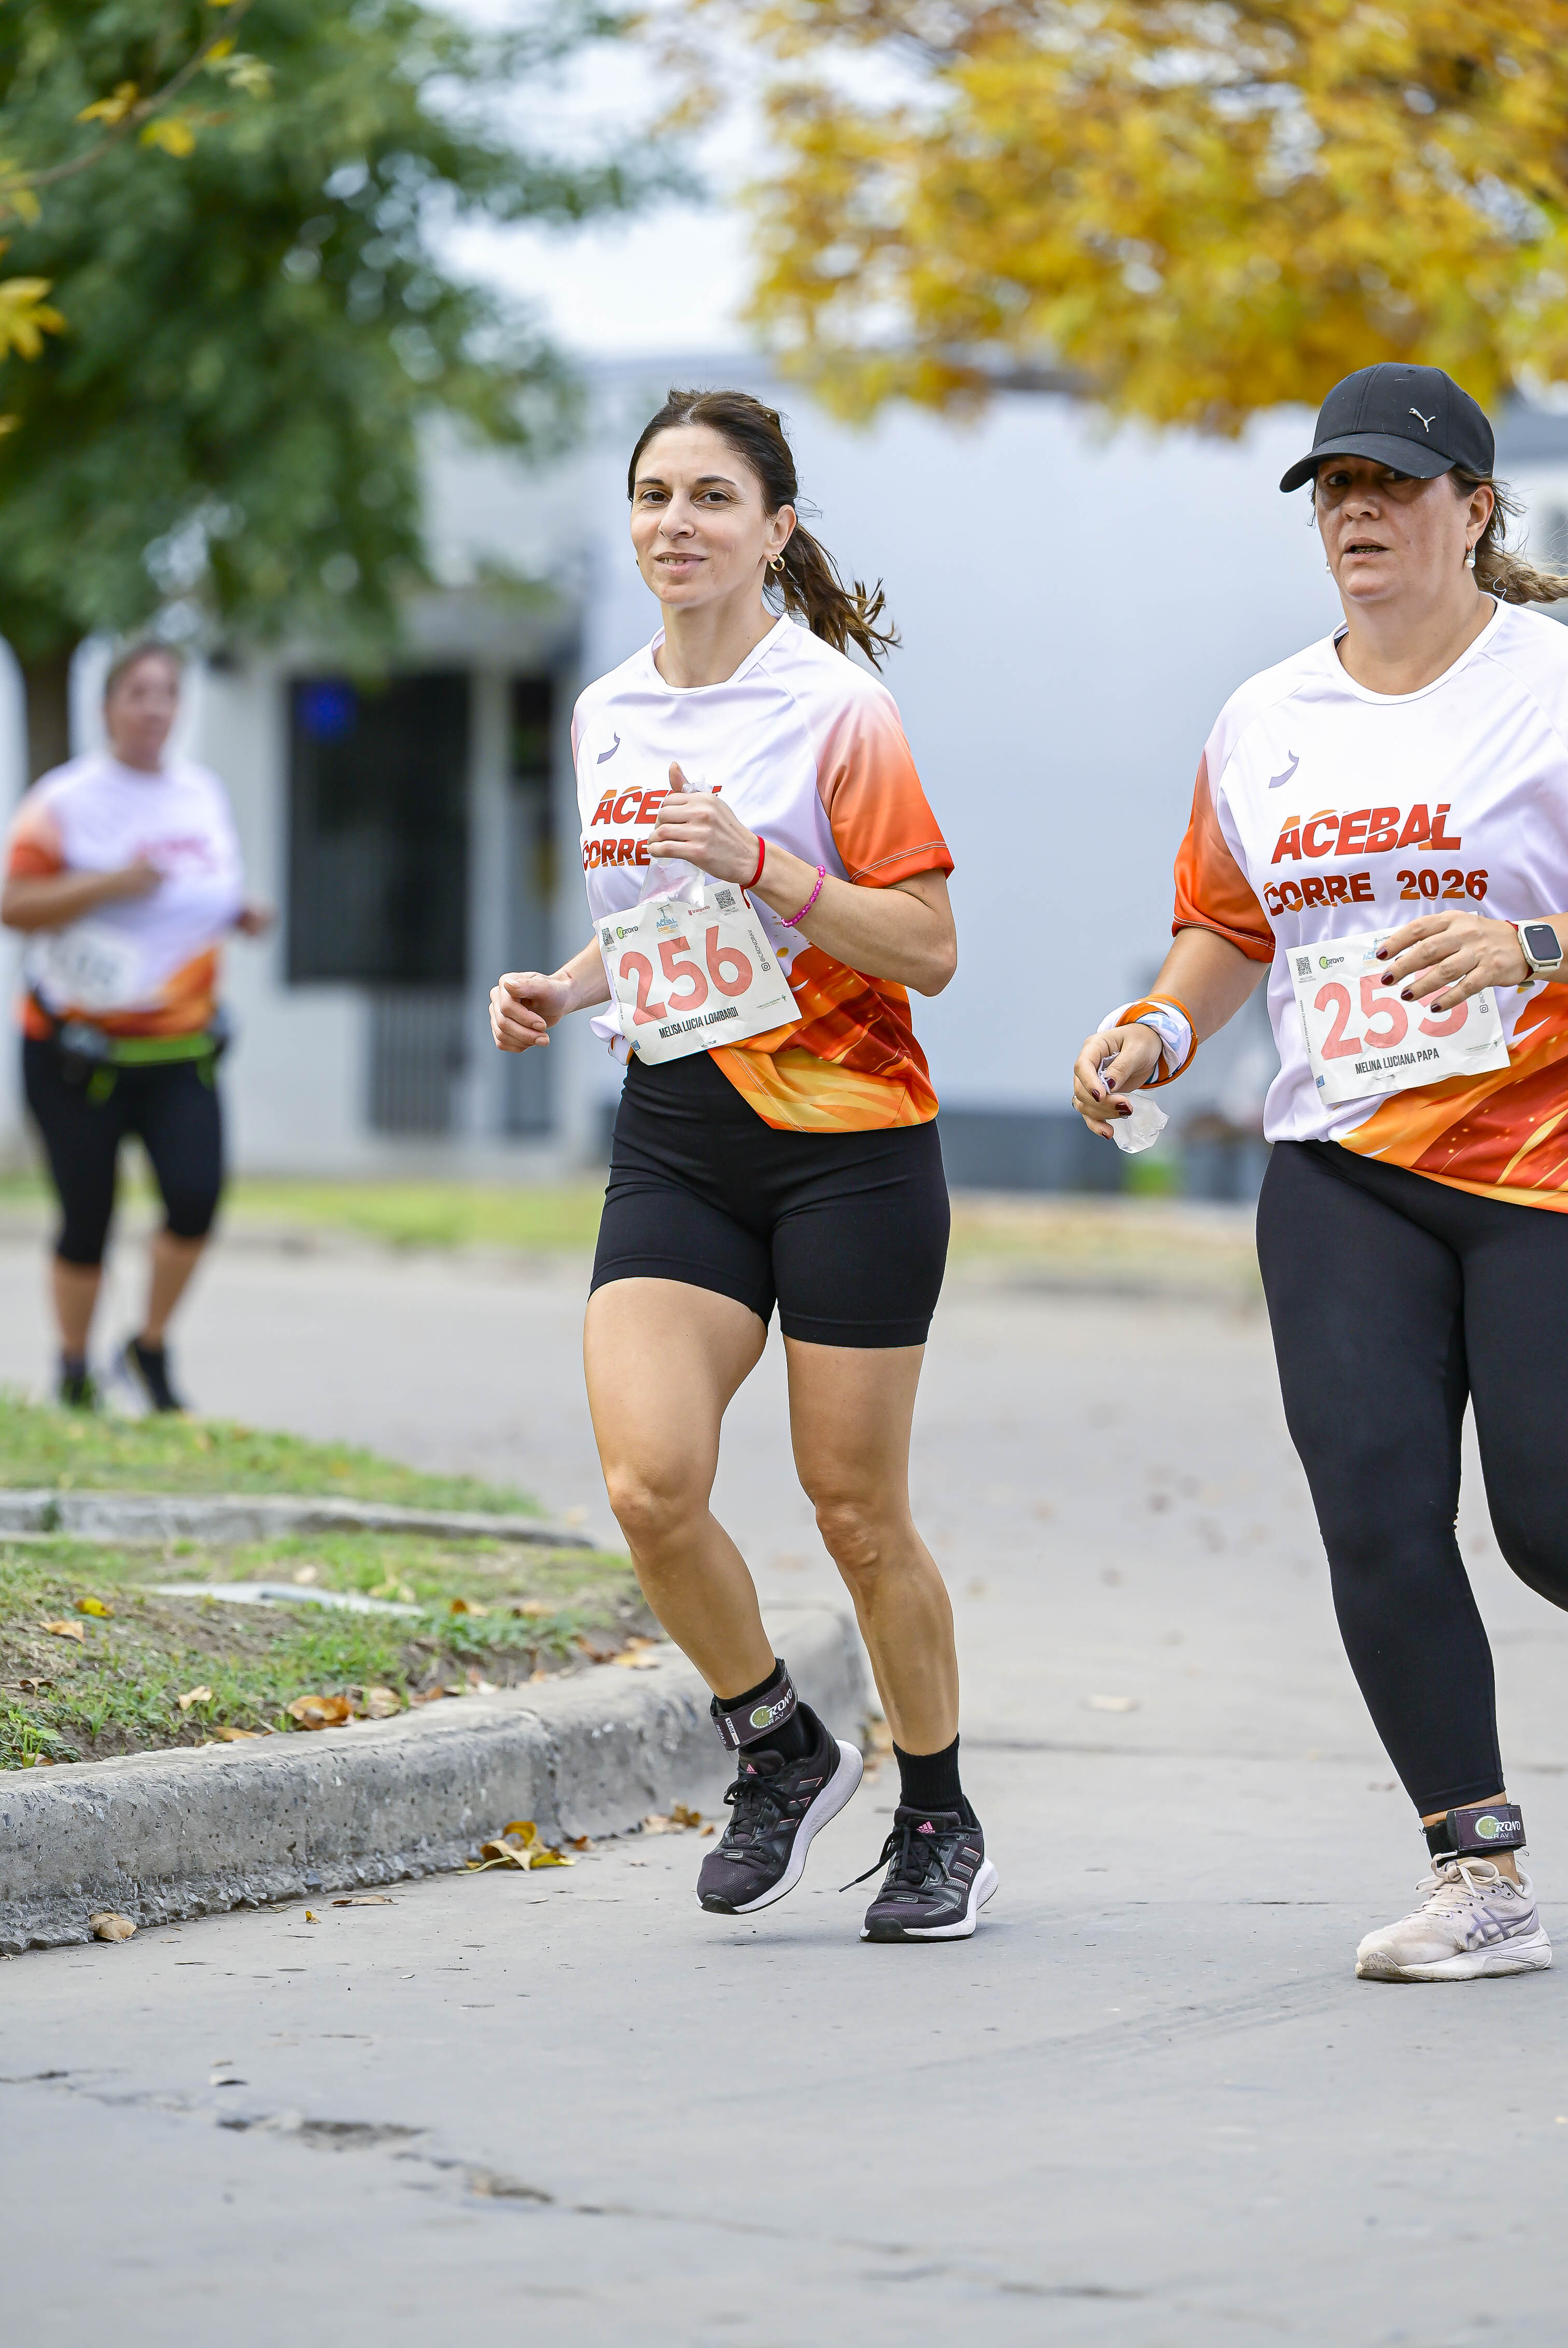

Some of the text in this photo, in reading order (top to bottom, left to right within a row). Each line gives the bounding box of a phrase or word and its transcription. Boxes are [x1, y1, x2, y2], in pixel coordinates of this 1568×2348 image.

[1271, 804, 1461, 864] ACEBAL
[583, 838, 651, 871] CORRE
[1264, 870, 1488, 916] CORRE 2026
[620, 925, 752, 1026] 256
[659, 1006, 739, 1039] MELISA LUCIA LOMBARDI
[1355, 1048, 1440, 1074] MELINA LUCIANA PAPA
[768, 1711, 783, 1725] RAV
